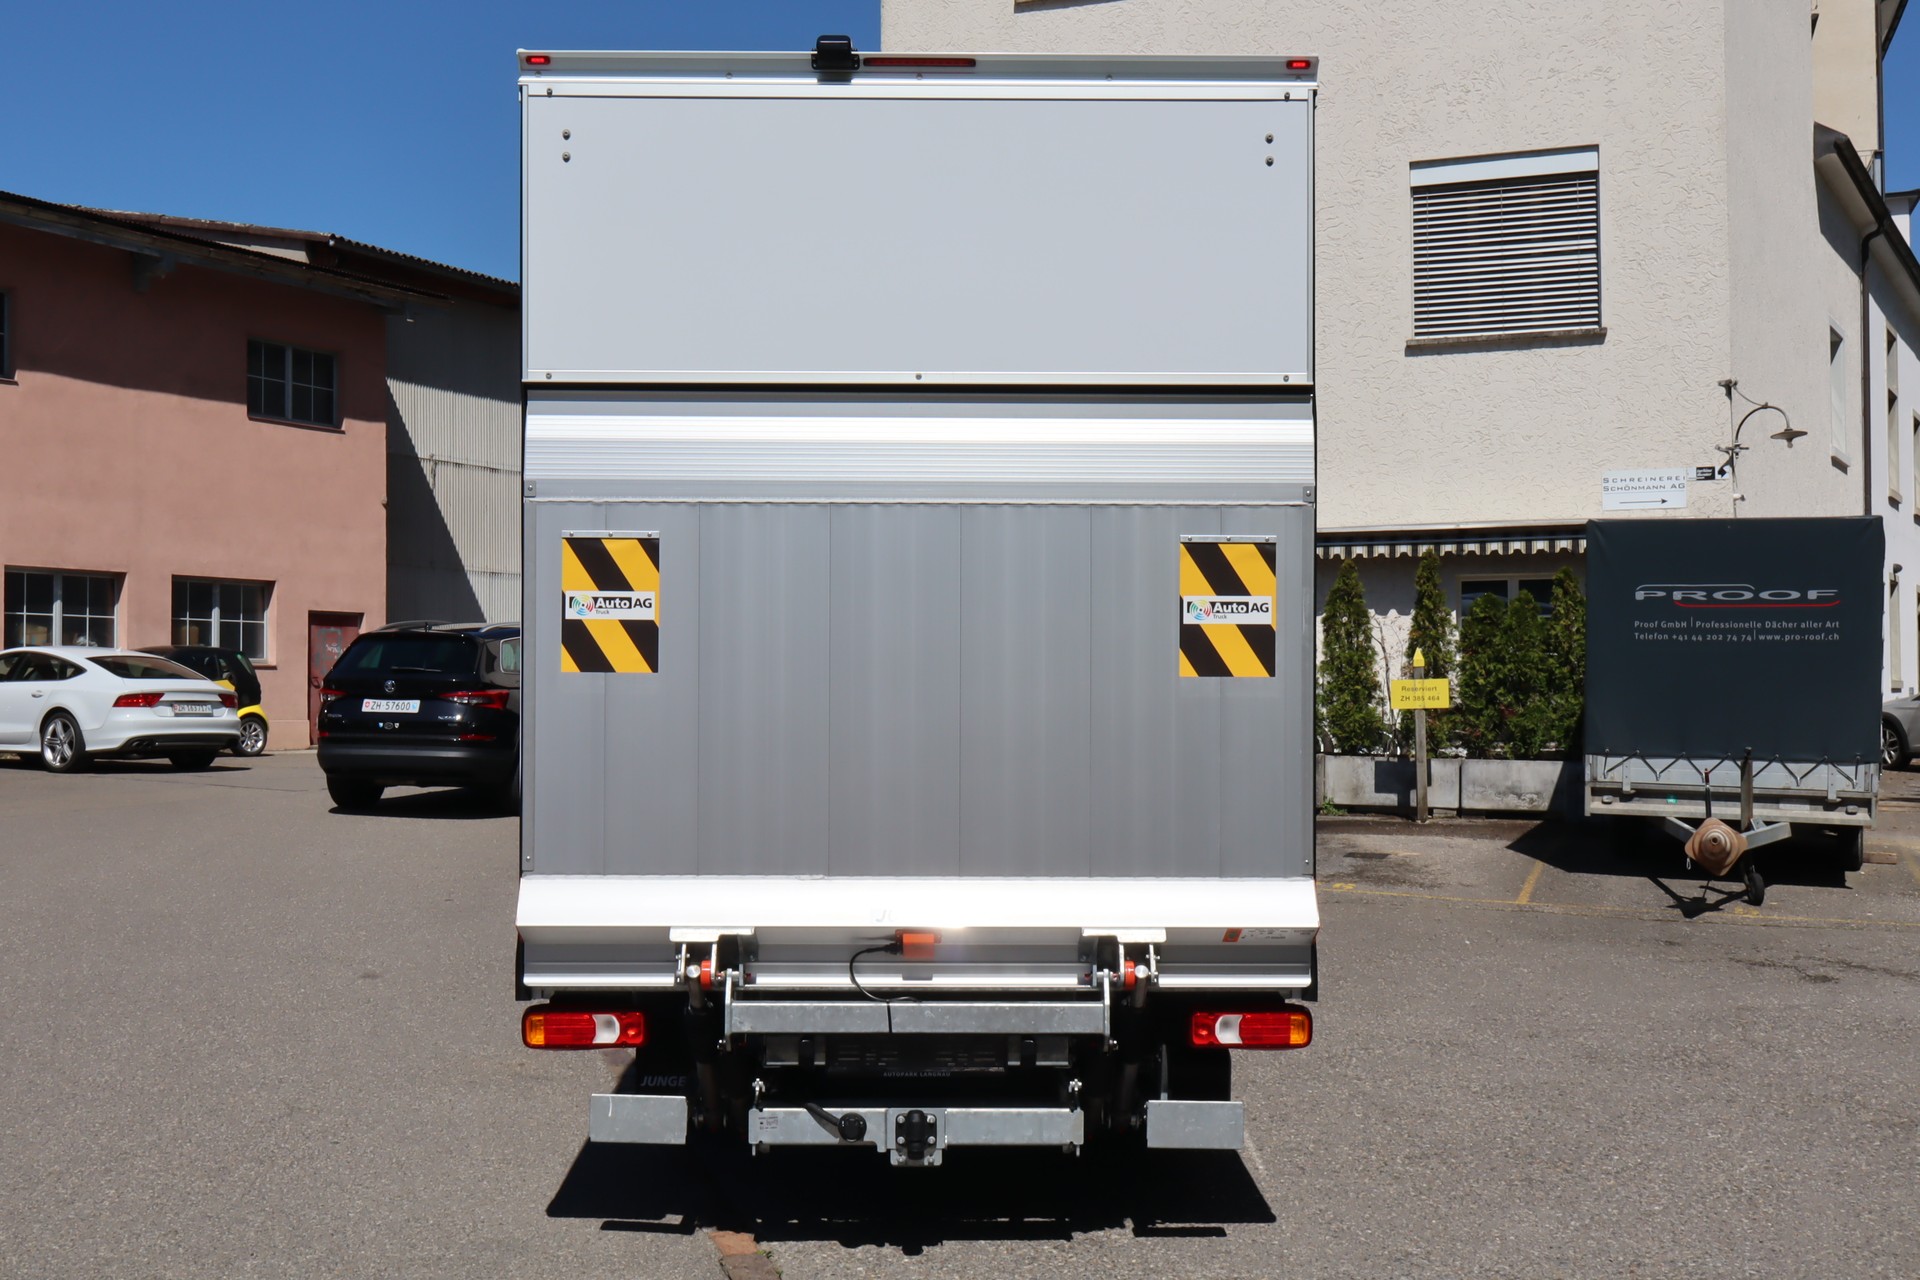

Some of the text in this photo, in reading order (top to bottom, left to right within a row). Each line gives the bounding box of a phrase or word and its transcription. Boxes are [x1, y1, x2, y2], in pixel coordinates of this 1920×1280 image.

[1603, 475, 1686, 484] SCHREINEREI
[1603, 484, 1666, 492] SCHÖNMANN
[1635, 590, 1838, 600] PROOF
[595, 597, 652, 608] Auto AG
[1213, 602, 1269, 613] Auto AG
[1634, 620, 1840, 629] Proof GmbH Professionelle Dächer aller Art
[1634, 632, 1669, 640] Telefon
[1672, 634, 1688, 642] +41
[1691, 634, 1703, 642] 44
[1726, 634, 1738, 642] 74
[1740, 634, 1752, 642] 74
[1758, 632, 1840, 642] www.pro-roof.ch
